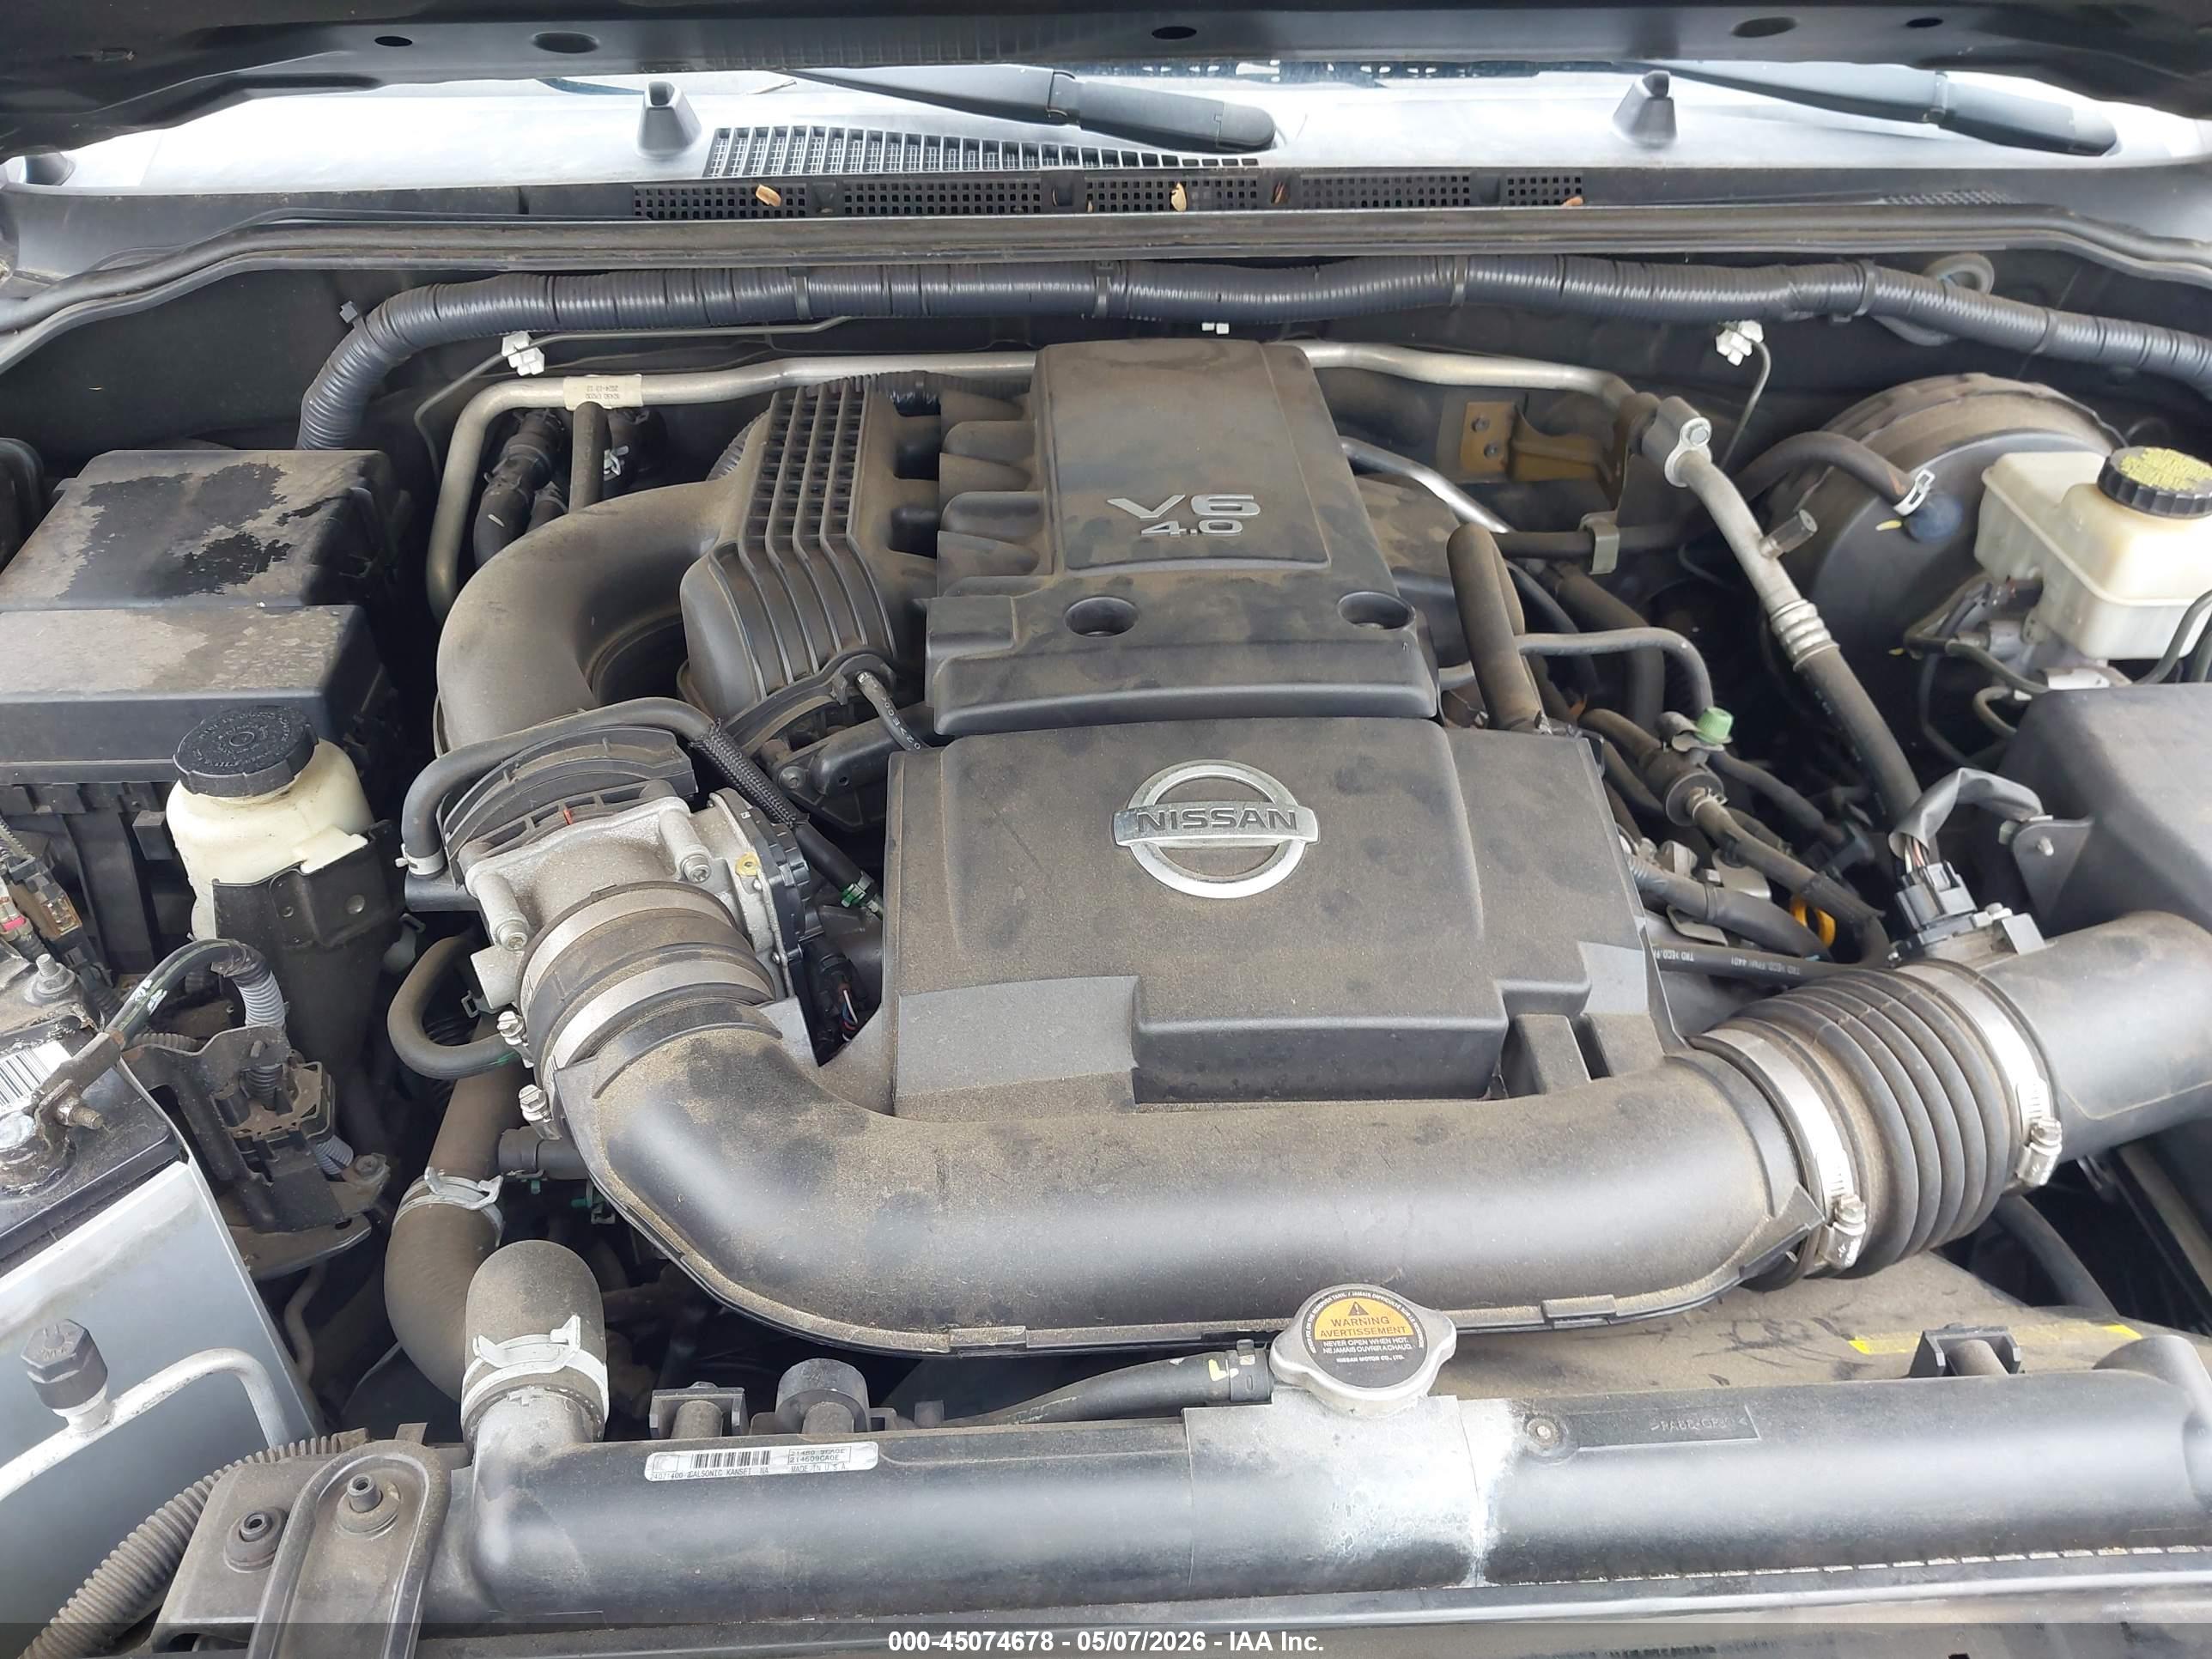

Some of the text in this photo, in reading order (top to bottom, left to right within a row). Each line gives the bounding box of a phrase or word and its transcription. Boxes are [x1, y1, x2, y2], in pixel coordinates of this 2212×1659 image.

[1107, 494, 1261, 519] V6
[1140, 519, 1243, 537] 4.0
[1136, 808, 1297, 832] NISSAN
[1330, 1316, 1390, 1328] WARNING
[1321, 1326, 1407, 1338] AVERTISSEMENT
